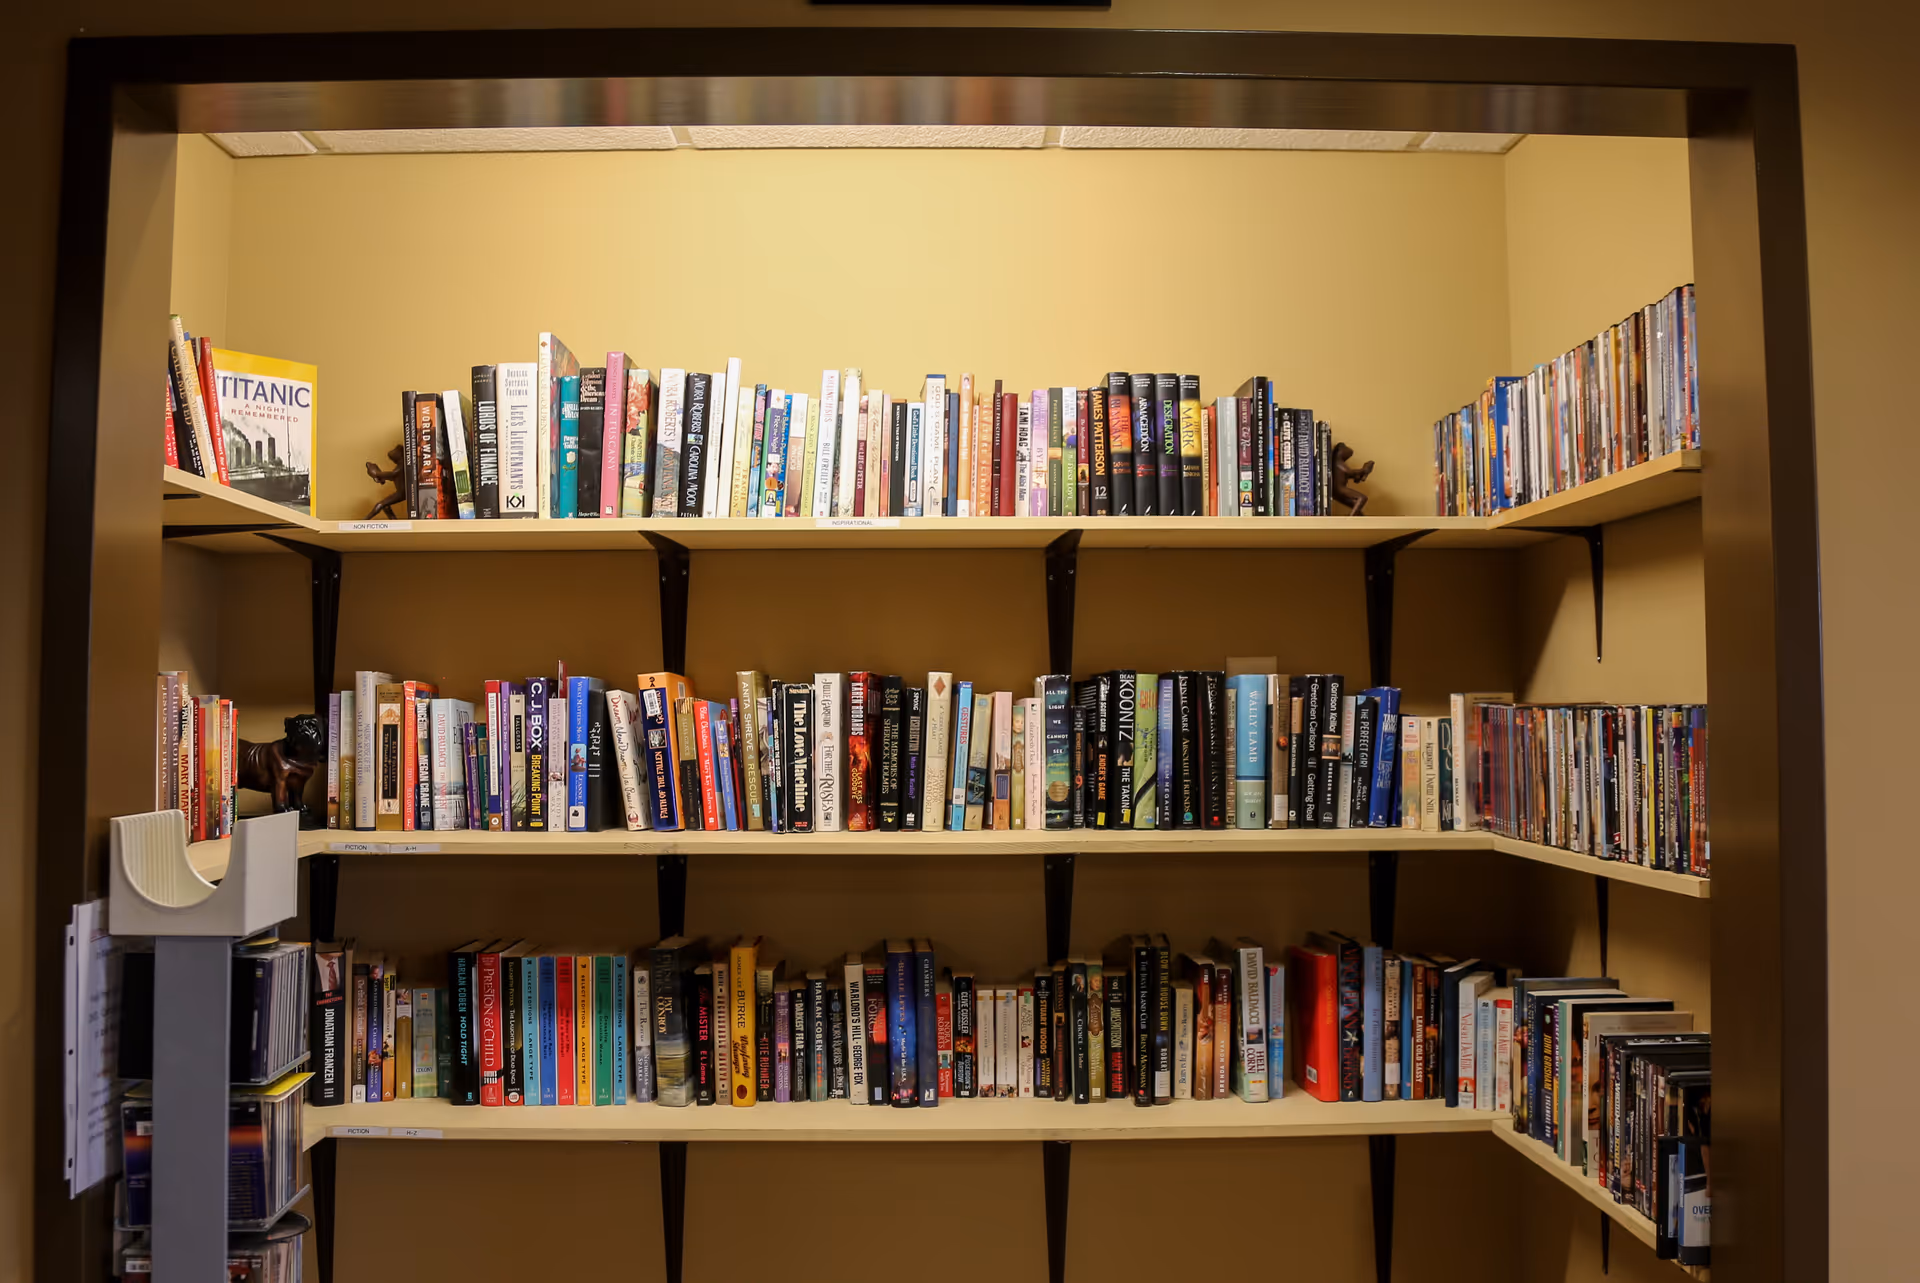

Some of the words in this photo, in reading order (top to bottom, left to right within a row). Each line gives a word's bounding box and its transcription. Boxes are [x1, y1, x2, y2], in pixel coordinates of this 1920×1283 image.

[171, 346, 180, 376] CALL
[176, 379, 184, 399] ME
[183, 402, 193, 426] TED
[217, 375, 310, 408] TITANIC
[694, 379, 705, 400] NORA
[231, 409, 299, 422] REMEMBERED
[255, 405, 285, 413] NIGHT
[478, 401, 495, 430] LORDS
[609, 403, 618, 416] IN
[690, 403, 704, 432] ROBERTS
[1019, 407, 1028, 425] TAMI
[1092, 390, 1102, 419] JAMES
[422, 406, 430, 441] WORLD
[1019, 427, 1028, 447] HOAG
[1139, 397, 1149, 451] ARMAGEDDON
[1163, 400, 1173, 454] DESECRATION
[1181, 407, 1193, 448] MARK
[216, 437, 224, 455] Heart
[479, 433, 496, 444] OF
[608, 420, 616, 470] TUSCANY
[1094, 422, 1104, 475] PATTERSON
[1298, 435, 1308, 456] DAVID
[423, 444, 431, 466] WAR
[480, 448, 498, 486] FINANCE
[687, 446, 701, 480] CAROLINA
[1019, 475, 1027, 487] Alibi
[1298, 459, 1309, 493] BALDACCI
[685, 482, 698, 507] MOON
[531, 682, 542, 697] C.
[741, 681, 752, 709] ANITA
[851, 682, 864, 703] KAREN
[1309, 683, 1319, 719] Gretchen
[1330, 683, 1339, 711] Garrison
[417, 703, 425, 722] ONCE
[531, 700, 542, 712] J.
[793, 701, 807, 726] The
[1118, 679, 1135, 741] KOONTZ
[1249, 690, 1257, 726] WALLY
[531, 715, 542, 749] BOX
[744, 713, 753, 752] SHREVE
[851, 705, 864, 736] ROBARDS
[960, 707, 969, 745] GESTURES
[1329, 712, 1337, 733] Keillor
[162, 727, 168, 745] ON
[794, 727, 806, 757] Love
[882, 718, 891, 759] SHERLOCK
[1249, 732, 1257, 763] LAMB
[1309, 721, 1317, 751] Carlson
[419, 755, 429, 782] MEGAN
[531, 754, 541, 792] BREAKING
[890, 741, 898, 777] MEMOIRS
[1098, 754, 1106, 781] ENDER'S
[748, 763, 757, 804] RESCUE
[794, 757, 808, 812] Machine
[890, 779, 898, 789] OF
[1122, 767, 1130, 782] THE
[1305, 773, 1315, 802] Getting
[420, 783, 430, 808] CRANE
[531, 793, 541, 816] POINT
[1098, 782, 1106, 800] GAME
[1307, 804, 1315, 821] Real
[458, 958, 466, 986] HARLAN
[1160, 952, 1168, 969] BLOW
[1247, 952, 1258, 979] DAVID
[483, 968, 494, 1015] PRESTON
[1160, 972, 1168, 985] THE
[458, 988, 466, 1012] COBEN
[664, 997, 672, 1013] PAT
[737, 990, 745, 1028] BURKE
[850, 981, 860, 1024] WARLORD'S
[1160, 987, 1168, 1009] HOUSE
[1248, 982, 1260, 1025] BALDACCI
[324, 1008, 334, 1047] JONATHAN
[484, 1017, 493, 1028] &
[657, 996, 665, 1034] CONROY
[699, 1006, 708, 1041] MISTER
[795, 1003, 804, 1031] DARKEST
[1160, 1012, 1168, 1031] DOWN
[1460, 1013, 1472, 1040] Nelson
[760, 1039, 769, 1055] KITE
[796, 1033, 804, 1049] FEAR
[852, 1025, 861, 1041] HILL
[1140, 1034, 1148, 1053] BRENT
[1543, 1033, 1552, 1055] JOHN
[484, 1029, 495, 1066] CHILD
[853, 1045, 862, 1070] GEORGE
[1461, 1042, 1472, 1072] DeMille
[324, 1048, 334, 1084] FRANZEN
[760, 1057, 769, 1089] RUNNER
[854, 1072, 863, 1085] FOX
[1544, 1056, 1553, 1090] GRISHAM
